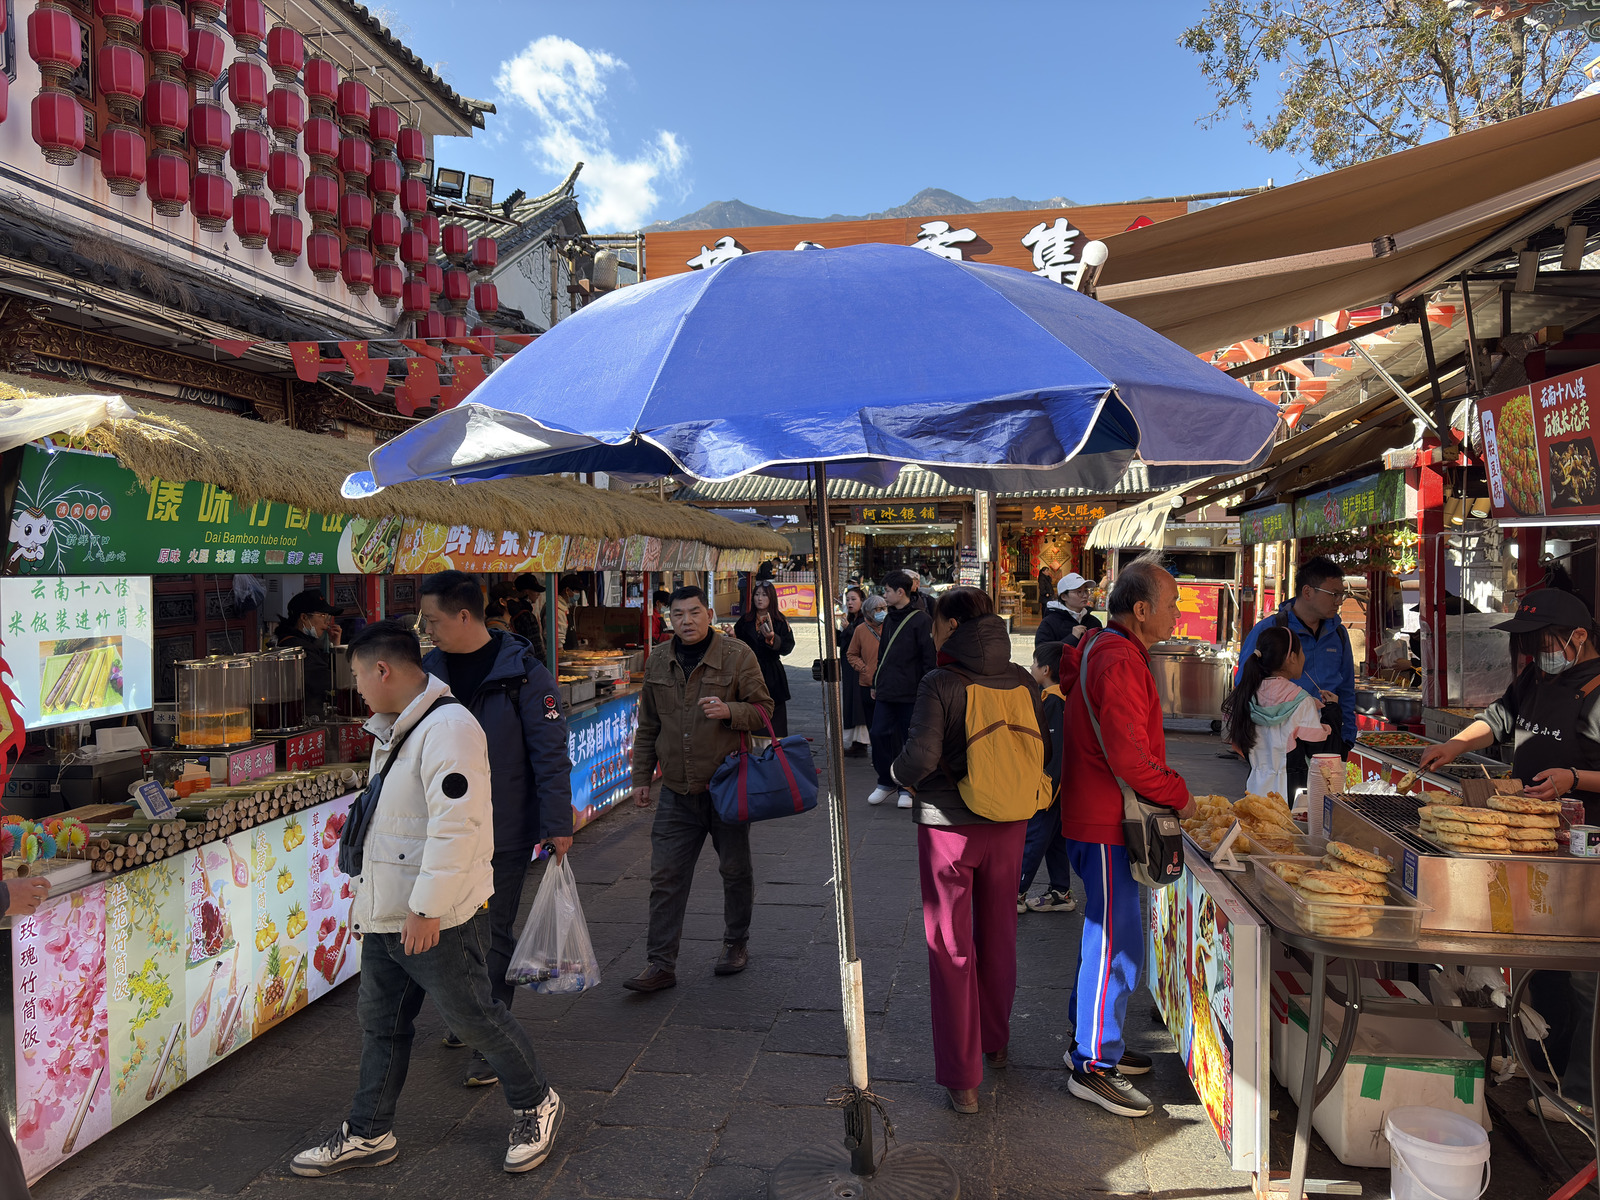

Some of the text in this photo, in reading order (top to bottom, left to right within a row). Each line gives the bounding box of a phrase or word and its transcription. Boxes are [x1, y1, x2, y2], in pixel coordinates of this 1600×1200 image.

[1342, 489, 1375, 516] 特产野生菌
[157, 548, 181, 564] 原味
[205, 531, 297, 546] Dai Bamboo tube food
[8, 604, 148, 637] 米饭装进竹筒卖
[30, 577, 130, 601] 云南十八怪
[256, 830, 269, 931] 菠萝竹筒饭
[310, 811, 322, 904] 草莓竹筒饭
[190, 855, 206, 962] 火腿竹筒饭
[110, 882, 130, 1001] 桂花竹筒饭
[18, 916, 41, 1050] 玫瑰竹筒饭
